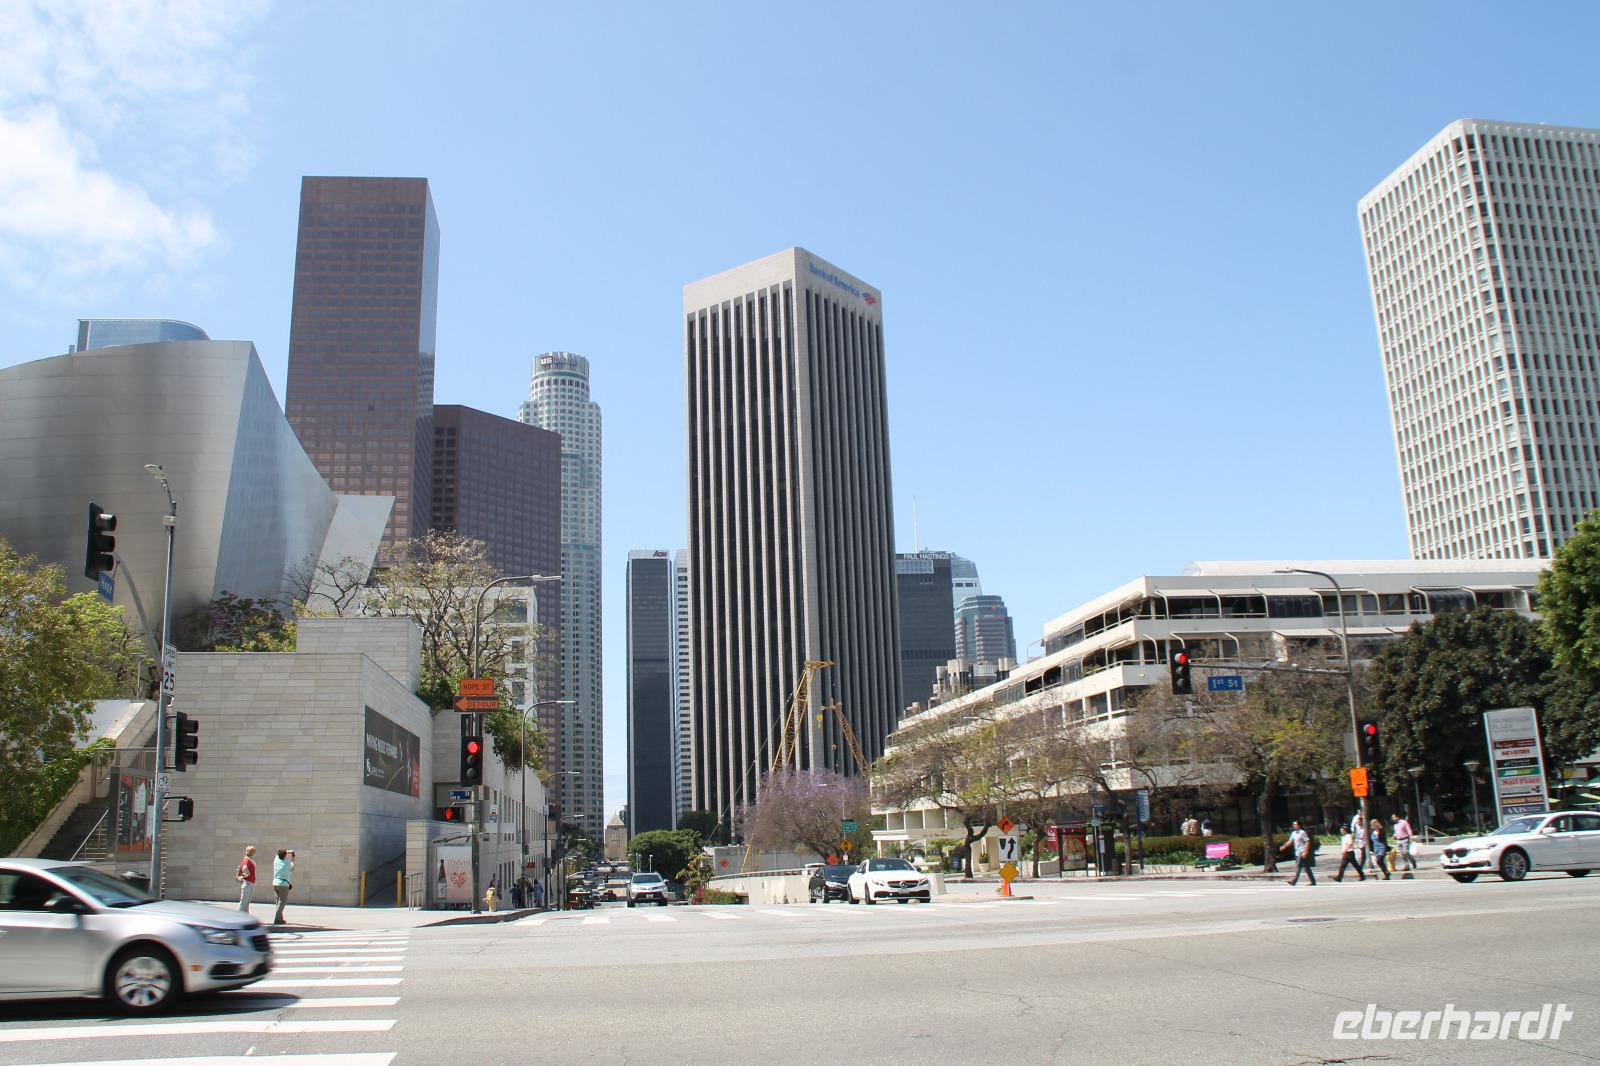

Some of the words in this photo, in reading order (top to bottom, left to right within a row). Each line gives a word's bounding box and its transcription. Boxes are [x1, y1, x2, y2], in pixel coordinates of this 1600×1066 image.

[834, 276, 860, 298] America
[164, 671, 175, 691] 25
[463, 683, 480, 691] HOPE
[482, 683, 490, 691] ST
[1212, 679, 1224, 689] 1st
[1227, 679, 1239, 688] St
